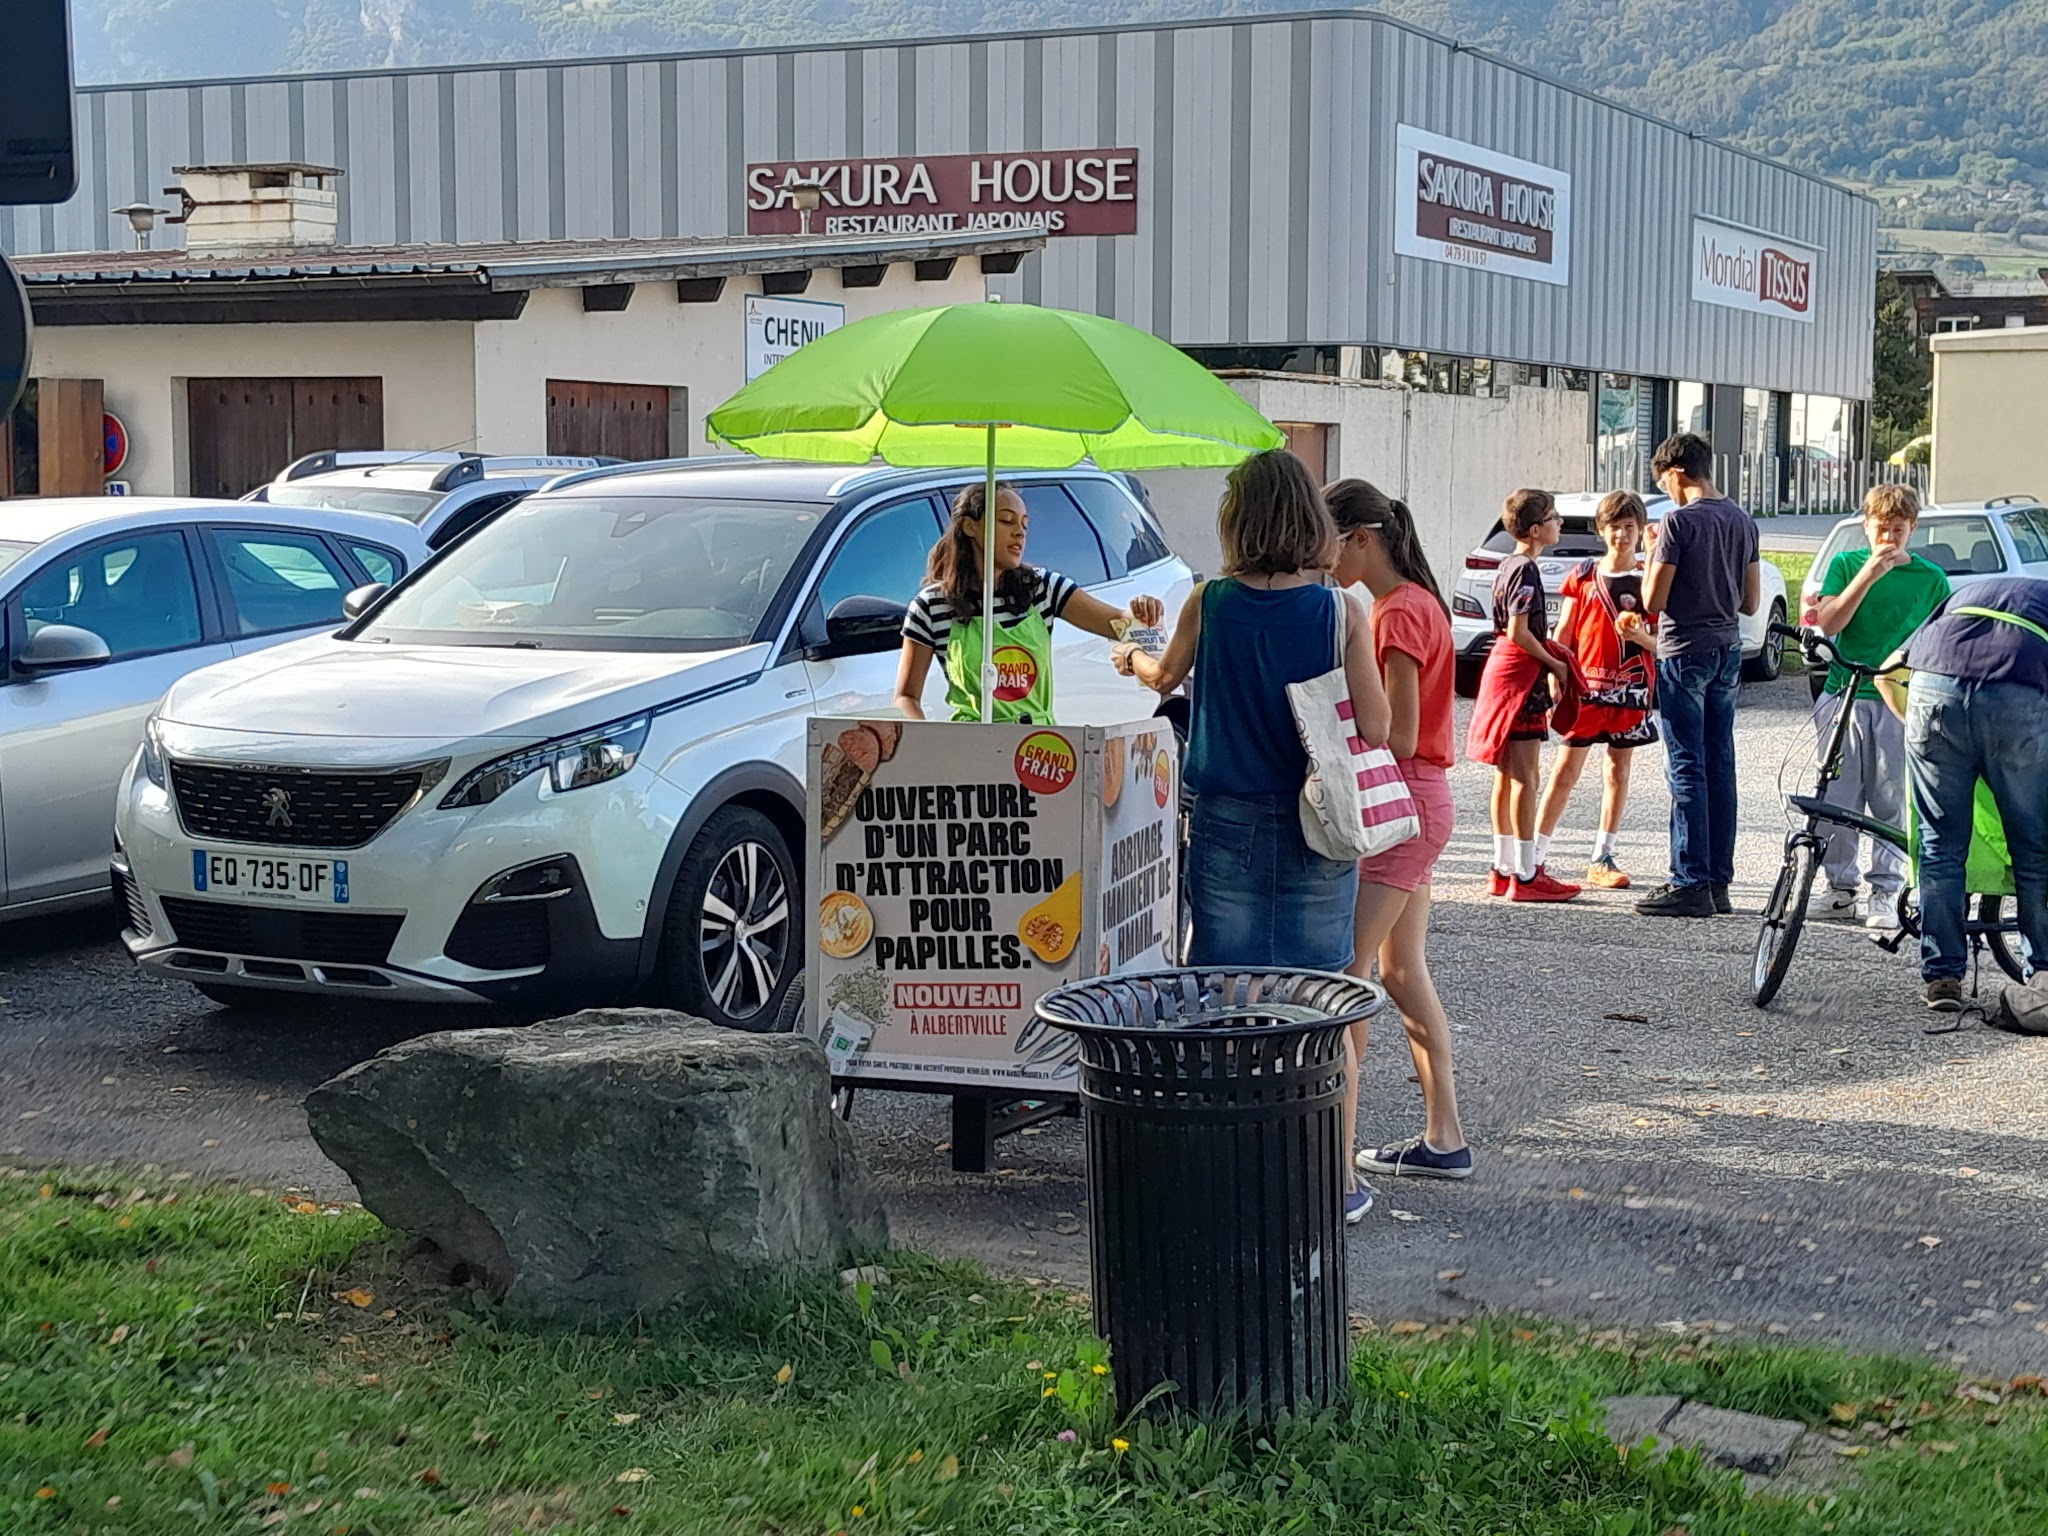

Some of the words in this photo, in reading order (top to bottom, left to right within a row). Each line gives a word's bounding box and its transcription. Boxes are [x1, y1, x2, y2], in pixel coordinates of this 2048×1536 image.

[748, 163, 938, 211] SAKURA
[970, 158, 1134, 204] HOUSE
[1419, 158, 1495, 218] SAKURA
[1502, 182, 1556, 232] HOUSE
[825, 212, 959, 236] RESTAURANT
[961, 210, 1065, 232] JAPONAIS
[1700, 235, 1757, 293] Mondial
[536, 458, 595, 468] DUSTER
[998, 673, 1028, 688] RAIS
[1021, 756, 1066, 783] FRAIS
[1025, 744, 1069, 769] GRAND
[855, 783, 1038, 822] OUVERTURE
[864, 823, 937, 859] D'UN
[947, 821, 1030, 857] PARC
[1111, 819, 1163, 884] ARRIVAGE
[335, 883, 348, 898] 73
[835, 858, 1063, 897] D'ATTRACTION
[1103, 864, 1157, 933] IMMINENT
[1158, 856, 1171, 900] DE
[909, 898, 992, 933] POUR
[875, 934, 1032, 970] PAPILLES.
[898, 985, 1018, 1007] NOUVEAU
[910, 1013, 919, 1035] À
[922, 1013, 1008, 1036] ALBERTVILLE
